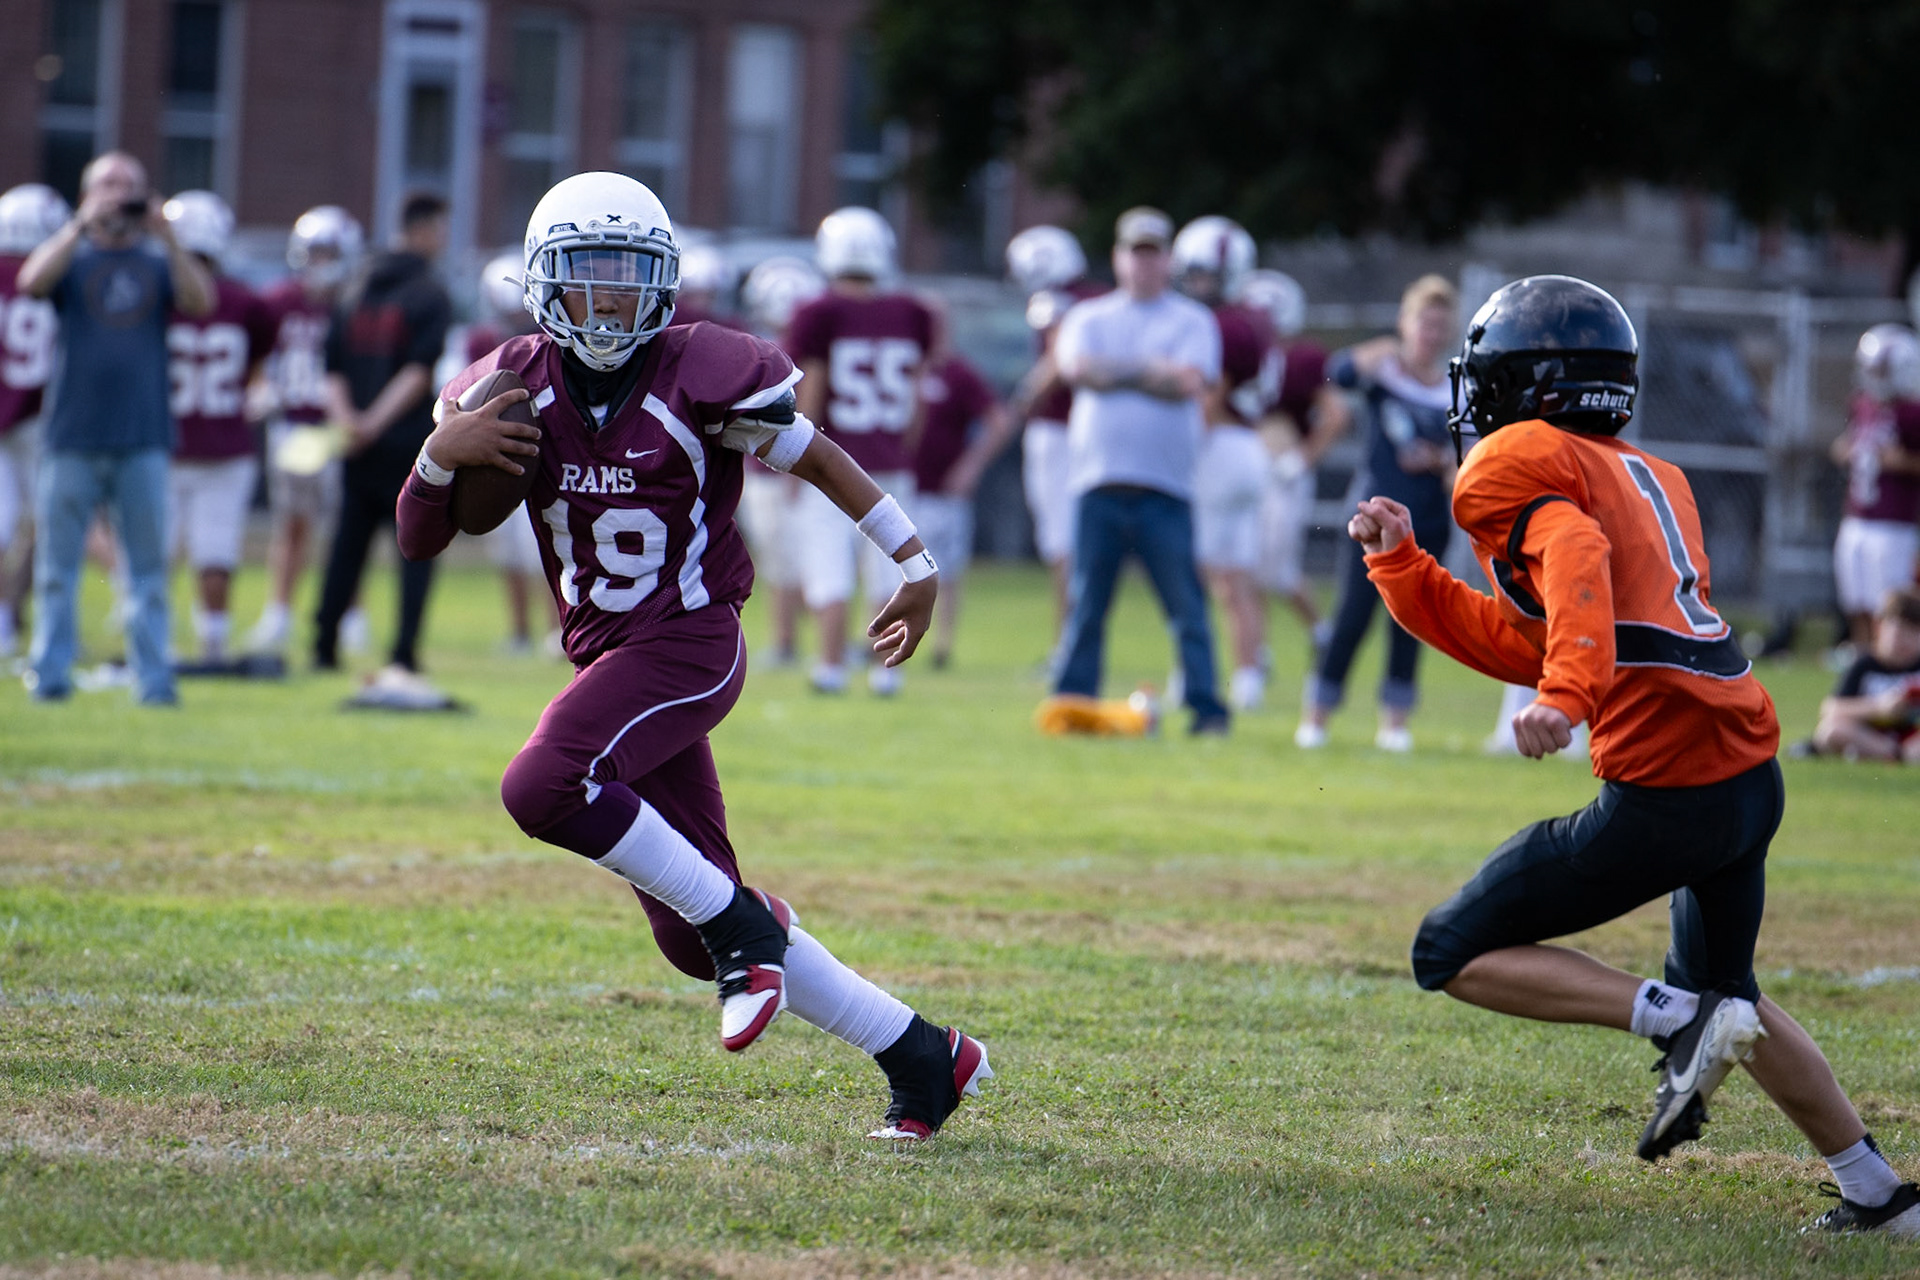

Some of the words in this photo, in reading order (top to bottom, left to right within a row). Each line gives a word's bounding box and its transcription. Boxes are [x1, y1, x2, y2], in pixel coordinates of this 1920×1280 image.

[829, 337, 920, 434] 55
[1580, 390, 1630, 408] schutt
[559, 463, 636, 494] RAMS
[541, 498, 668, 613] 19
[1617, 452, 1723, 634] 1
